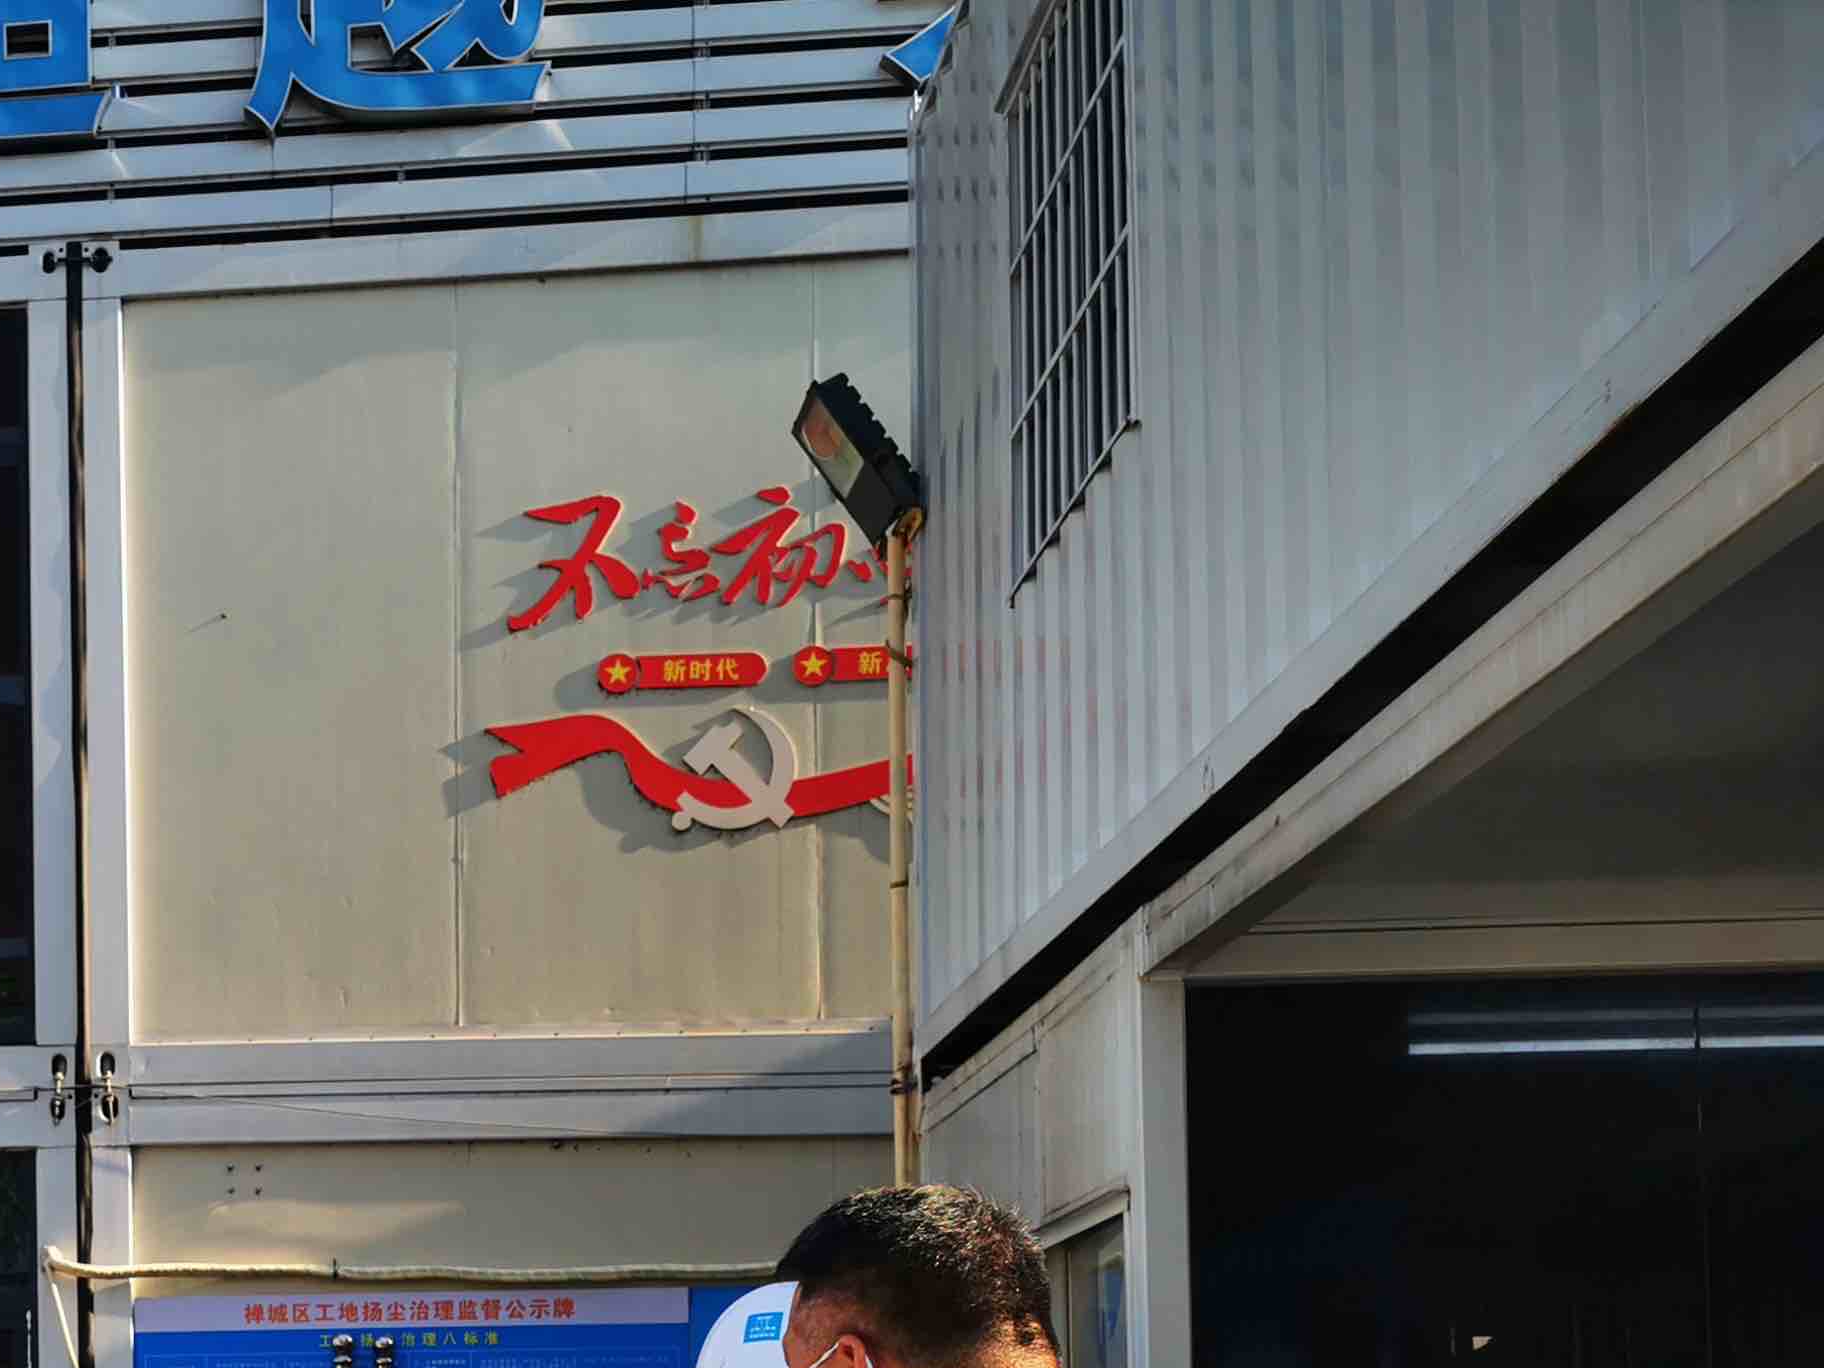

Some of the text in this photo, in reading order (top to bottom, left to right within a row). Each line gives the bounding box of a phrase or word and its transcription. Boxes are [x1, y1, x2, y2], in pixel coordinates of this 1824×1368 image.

[662, 657, 739, 683] 新时代
[243, 1297, 576, 1324] 禅城区工地扬尘治理监督公示牌
[319, 1331, 500, 1348] 工扬治理八标准
